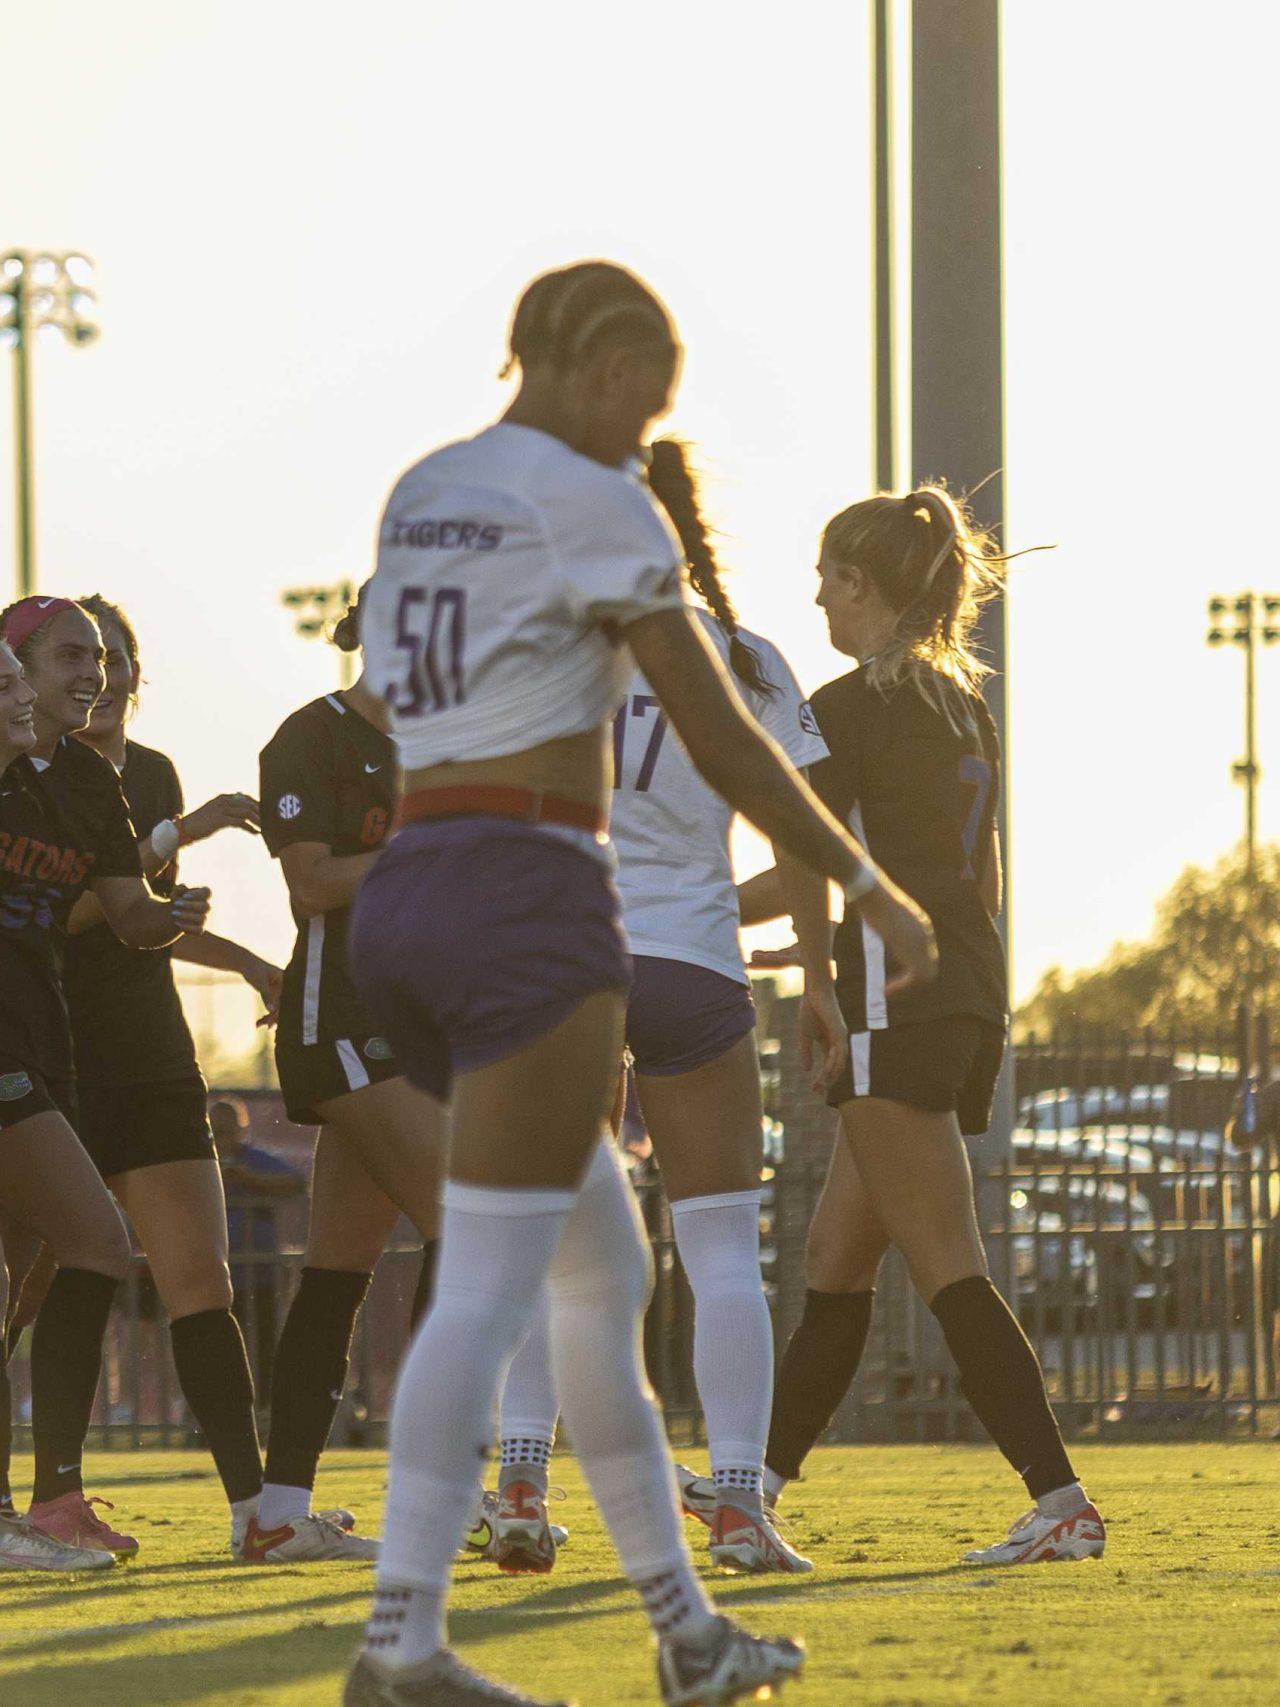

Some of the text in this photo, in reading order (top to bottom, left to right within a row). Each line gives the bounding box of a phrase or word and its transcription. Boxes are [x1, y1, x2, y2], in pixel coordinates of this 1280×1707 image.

[391, 519, 504, 551] TIGERS
[385, 586, 467, 718] 50
[278, 794, 302, 819] SEC
